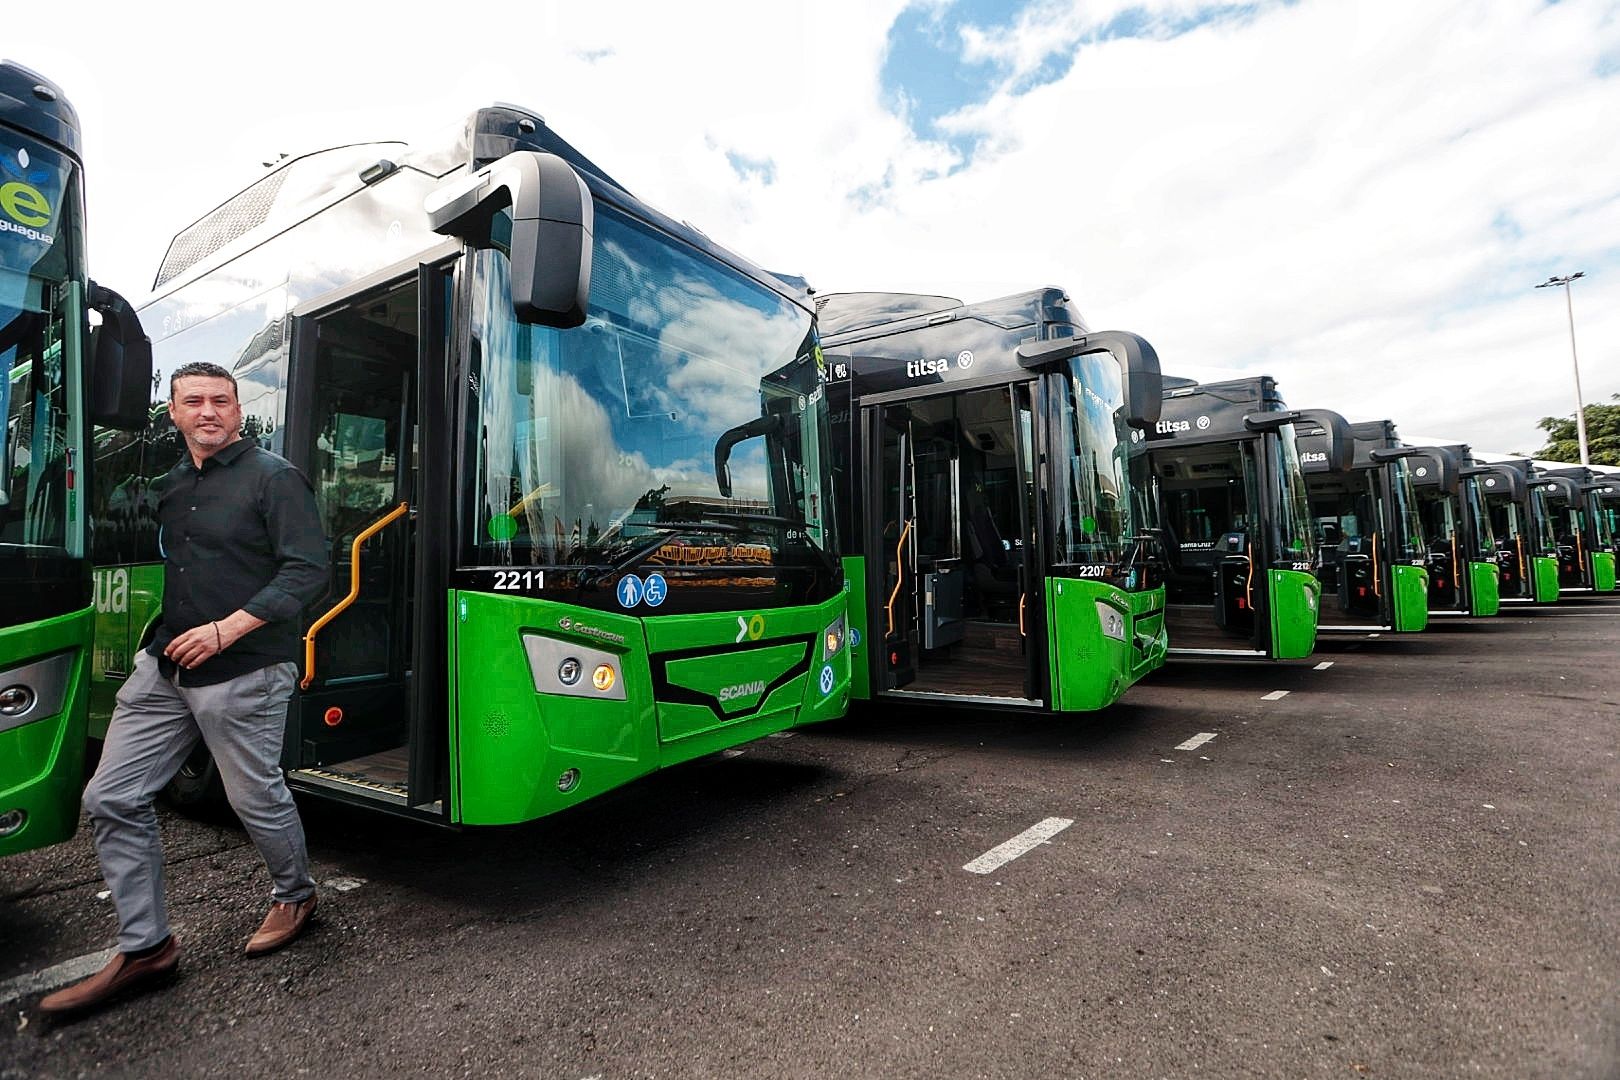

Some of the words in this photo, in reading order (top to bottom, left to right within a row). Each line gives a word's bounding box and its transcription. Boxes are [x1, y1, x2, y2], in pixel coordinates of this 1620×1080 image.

[907, 359, 948, 378] titsa
[1156, 420, 1190, 434] titsa
[1301, 452, 1327, 462] itsa
[494, 571, 544, 590] 2211
[1080, 565, 1106, 577] 2207
[93, 568, 128, 614] ua
[719, 680, 766, 701] SCANIA
